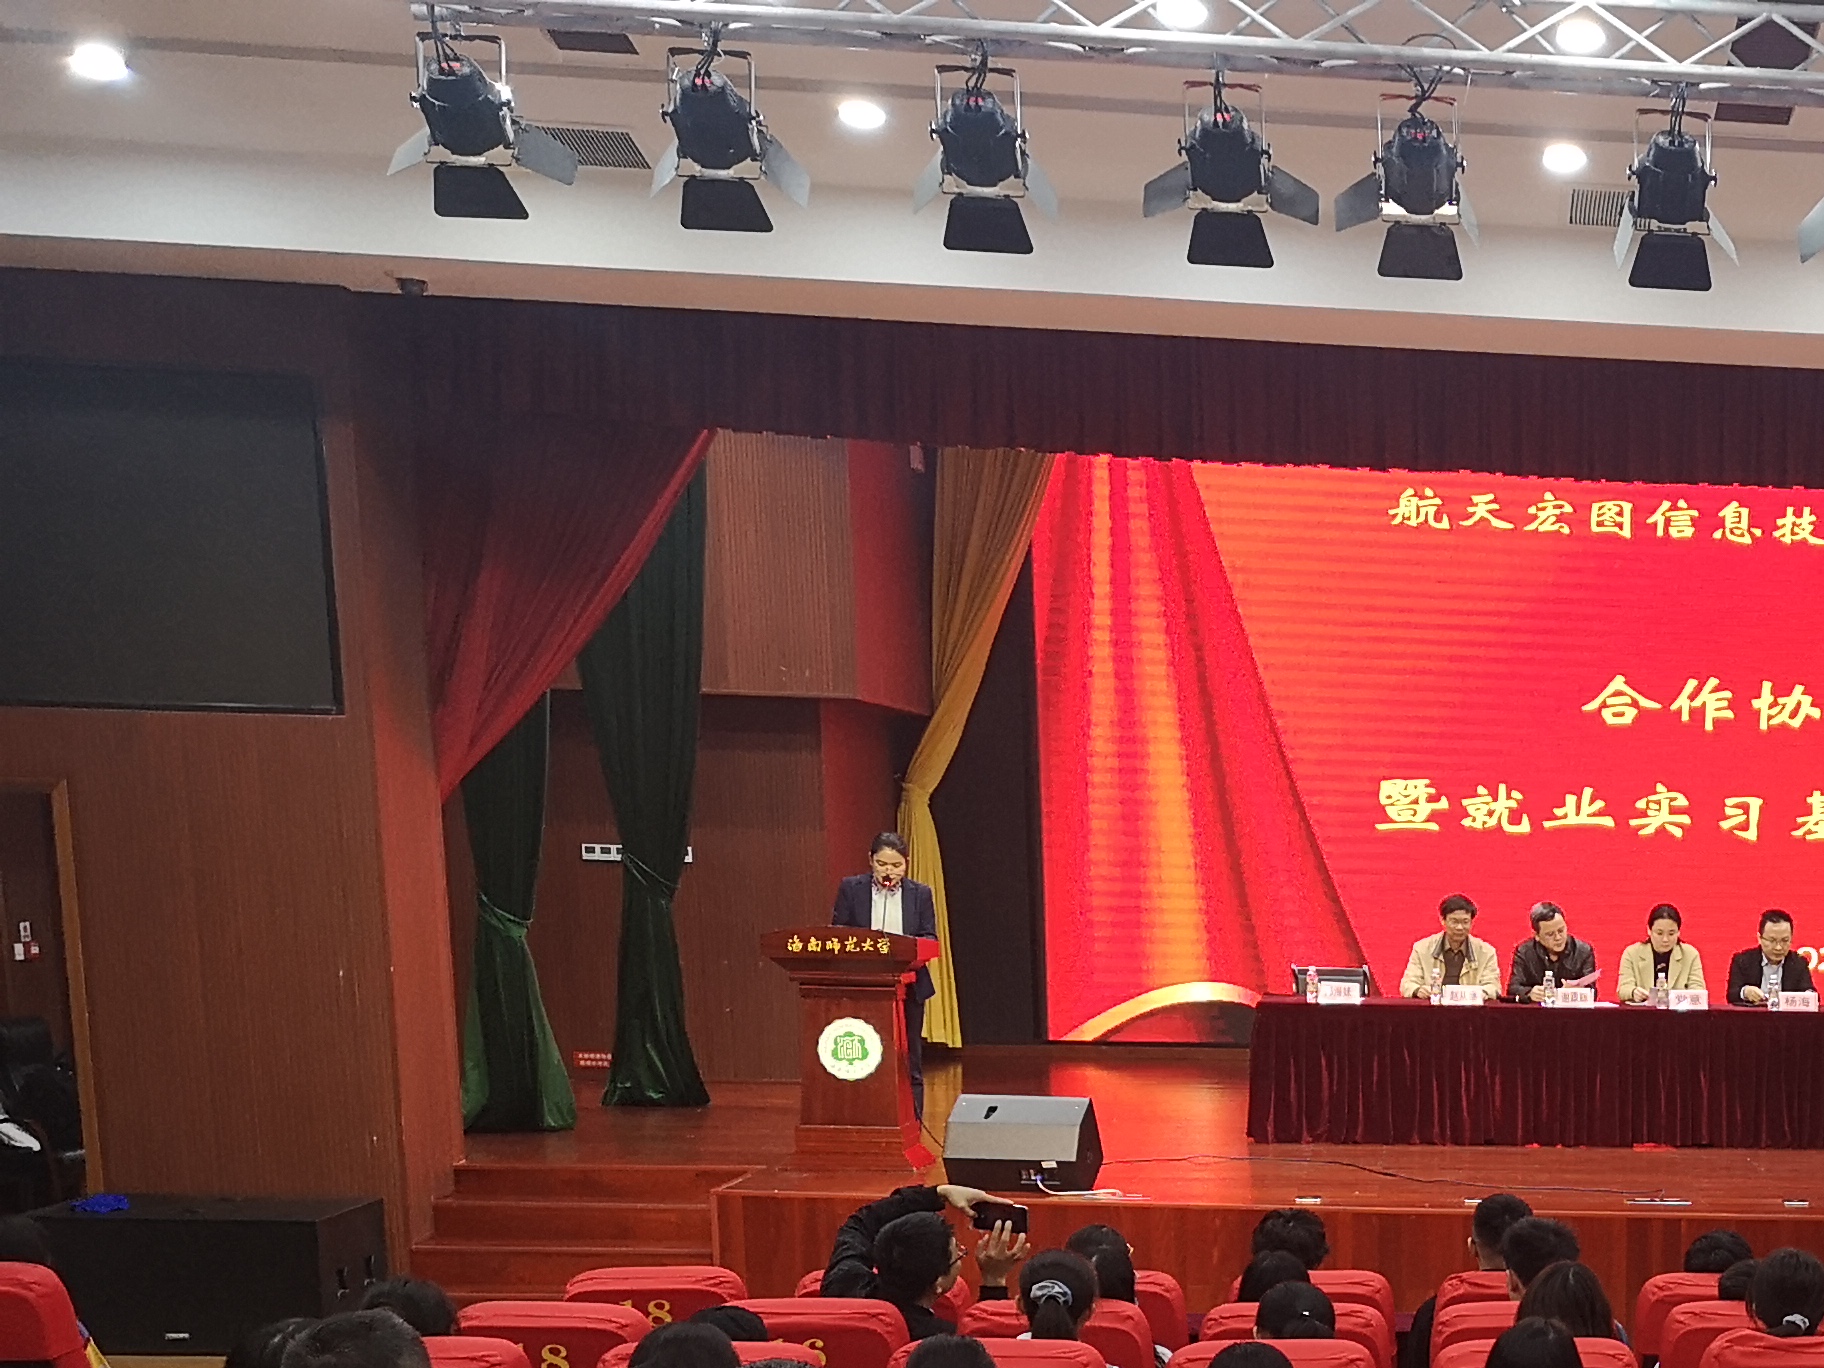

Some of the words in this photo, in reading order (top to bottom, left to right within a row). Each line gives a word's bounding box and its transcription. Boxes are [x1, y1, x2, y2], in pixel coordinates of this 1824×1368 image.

[787, 935, 891, 954] 海南师范大学
[1784, 996, 1811, 1008] 杨海
